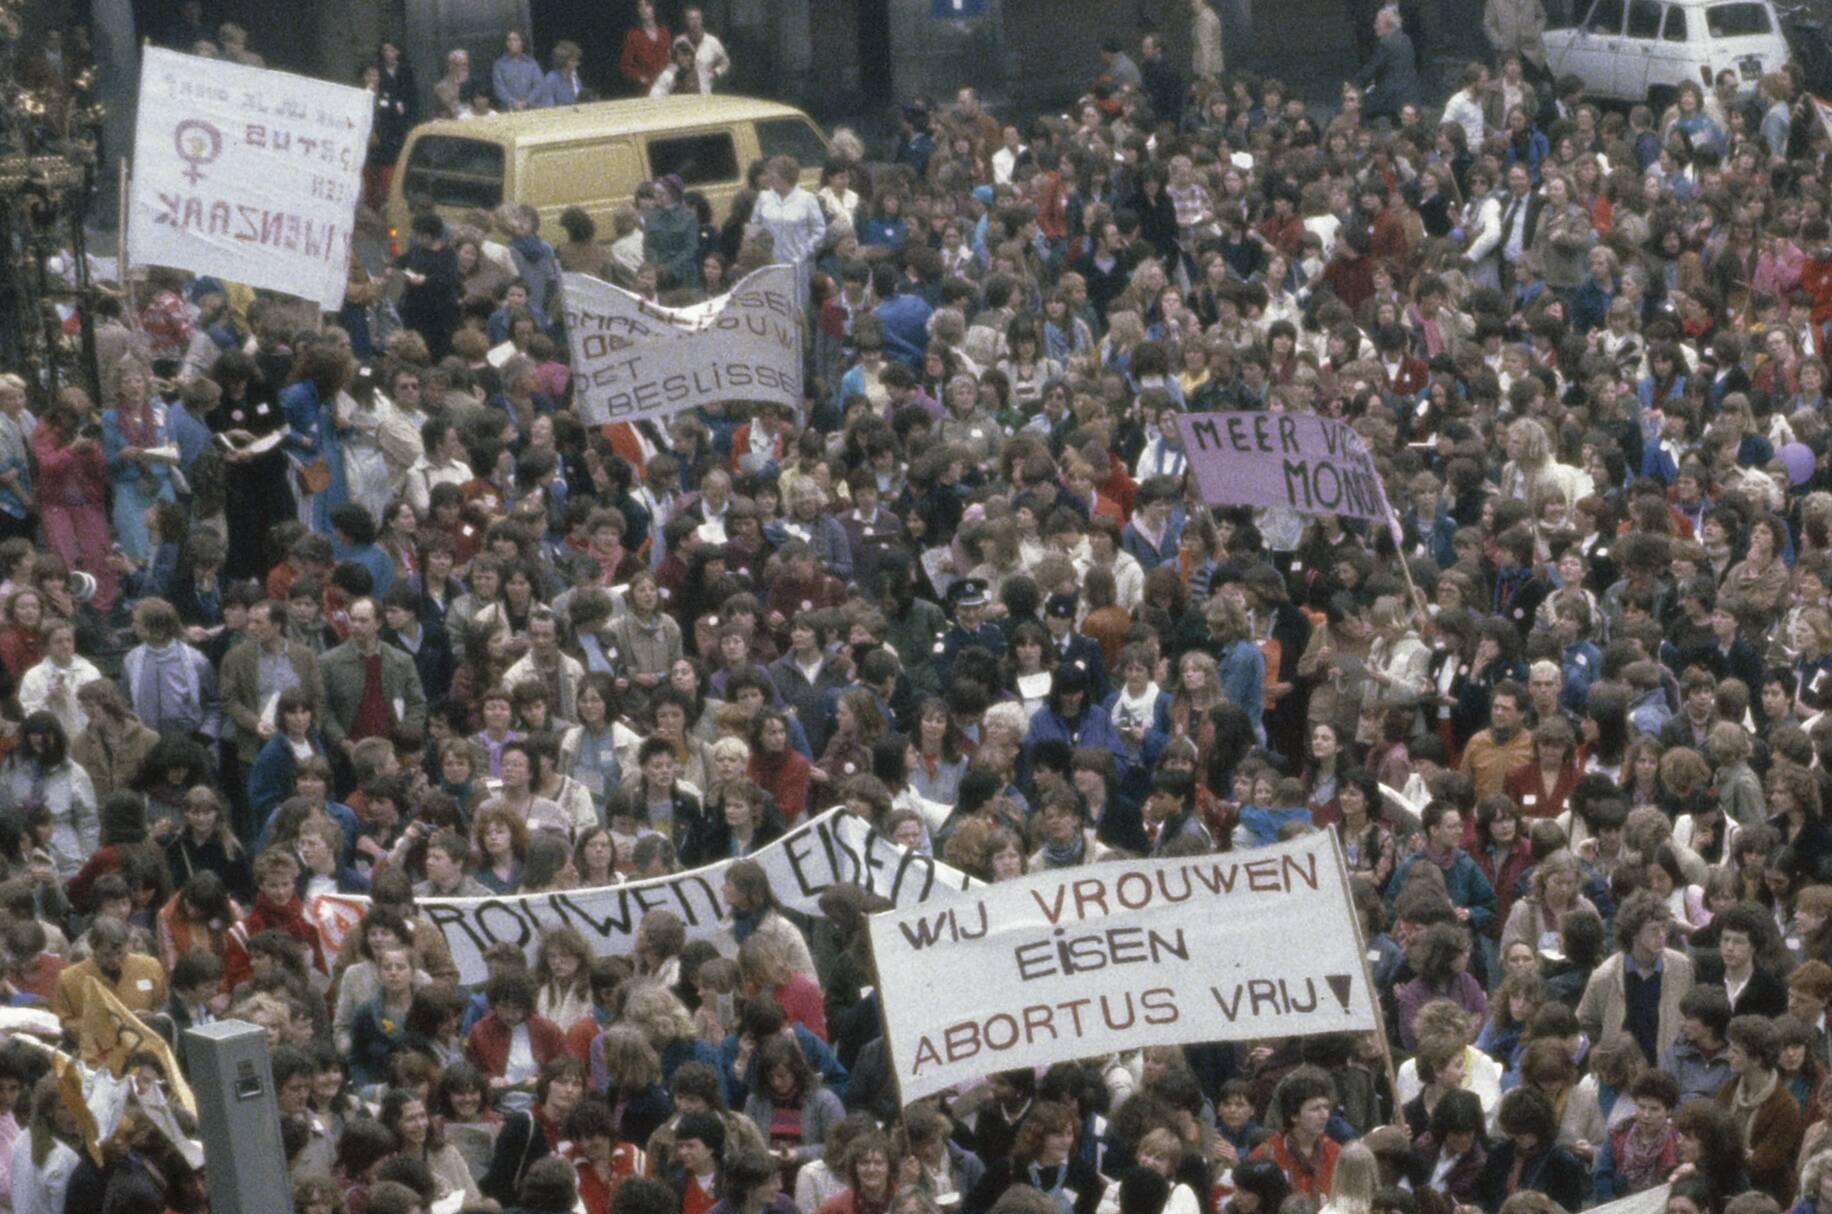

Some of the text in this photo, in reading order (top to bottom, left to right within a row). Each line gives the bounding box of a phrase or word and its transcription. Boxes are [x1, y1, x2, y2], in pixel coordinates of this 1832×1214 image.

[1191, 415, 1300, 454] MEER
[423, 876, 728, 953] ROUWEN
[897, 851, 1320, 951] WIJ VROUWEN
[911, 986, 1181, 1076] ABORTUS
